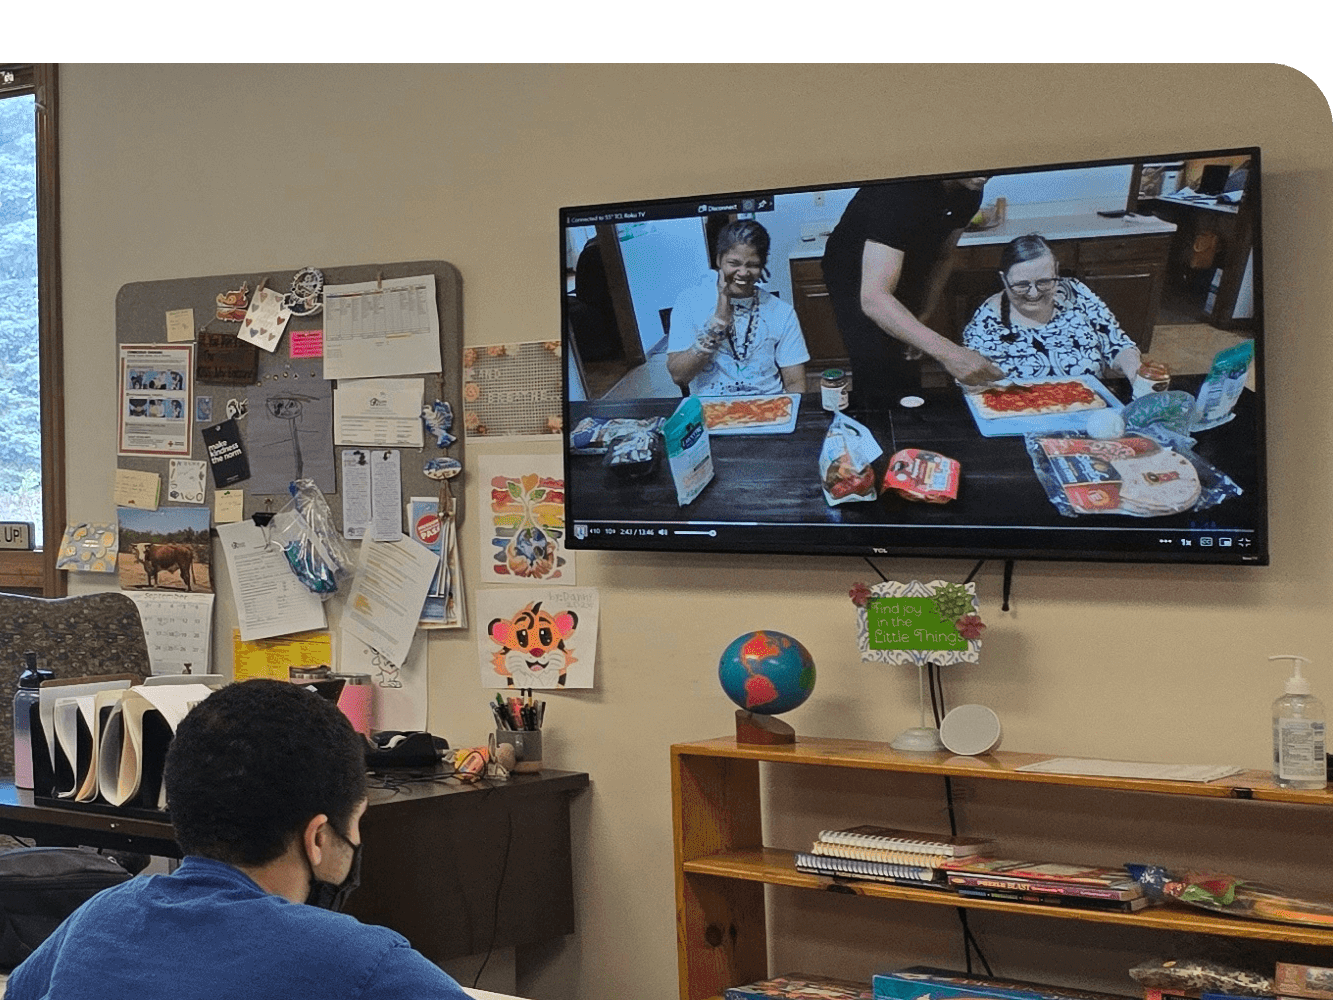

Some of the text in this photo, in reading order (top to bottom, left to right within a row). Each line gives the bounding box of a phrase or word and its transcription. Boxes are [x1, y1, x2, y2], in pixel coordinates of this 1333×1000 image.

[208, 440, 228, 451] make
[223, 448, 243, 460] norm
[638, 528, 655, 536] 13:46
[902, 600, 923, 617] joy
[876, 616, 913, 627] in the
[874, 628, 910, 643] Little
[1007, 882, 1032, 891] BLAST
